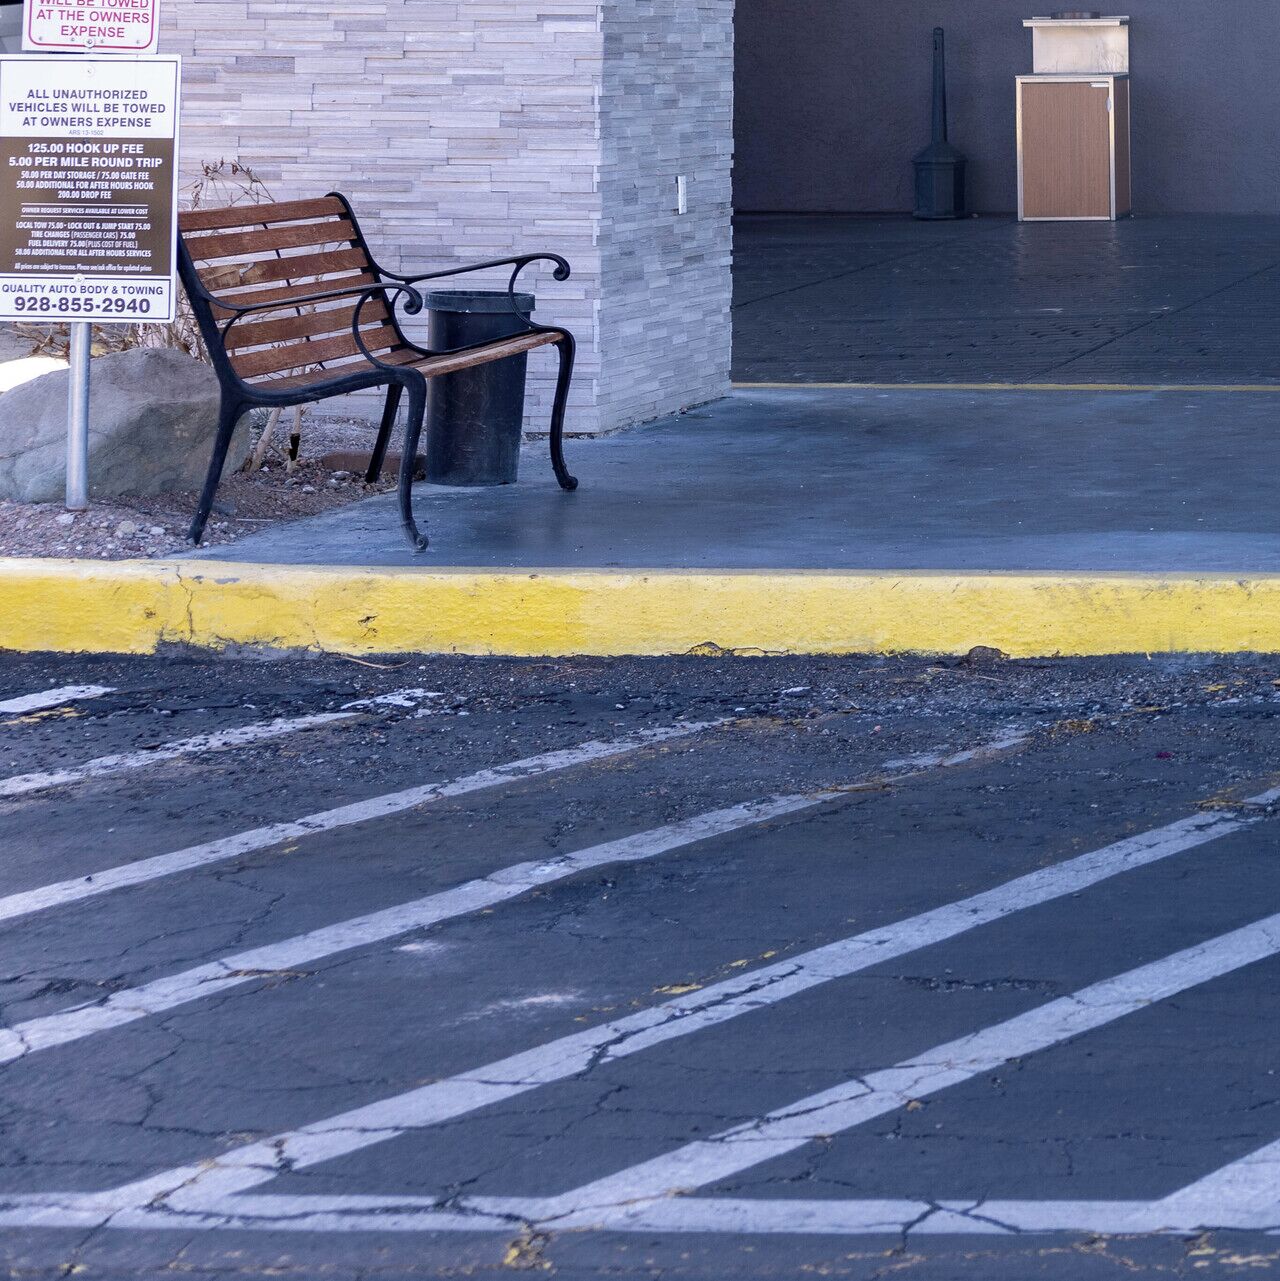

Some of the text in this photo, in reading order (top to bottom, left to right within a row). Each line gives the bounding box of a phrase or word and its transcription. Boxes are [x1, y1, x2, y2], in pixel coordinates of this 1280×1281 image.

[36, 9, 150, 24] AT THE OWNERS
[60, 25, 125, 38] EXPENSE
[27, 89, 148, 100] ALL UNAUTHORIZED
[9, 102, 166, 114] VEHICLES WILL BE TOWED
[22, 116, 152, 127] AT OWNERS EXPENSE
[27, 143, 144, 154] 125.00 HOOK UP FEE
[9, 157, 163, 168] 5.00 PER MILE ROUND TRIP
[20, 171, 39, 179] 50.00
[40, 171, 52, 179] PER
[53, 171, 66, 179] DAY
[67, 171, 96, 179] STORAGE
[101, 171, 120, 180] 75.00
[120, 171, 137, 180] GATE
[138, 172, 150, 180] FEE
[16, 181, 154, 190] 50.00 ADDITIONAL FOR AFTER HOURS HOOK
[58, 190, 112, 199] 200.00 DROP FEE
[15, 221, 33, 229] LOCAL
[34, 221, 47, 229] TOW
[83, 222, 96, 230] OUT
[96, 222, 101, 230] &
[31, 230, 44, 238] TIRE
[15, 248, 31, 256] 50.00
[31, 248, 66, 256] ADDITIONAL
[2, 284, 164, 295] QUALITY AUTO BODY & TOWING
[14, 296, 151, 314] 928-855-2940
